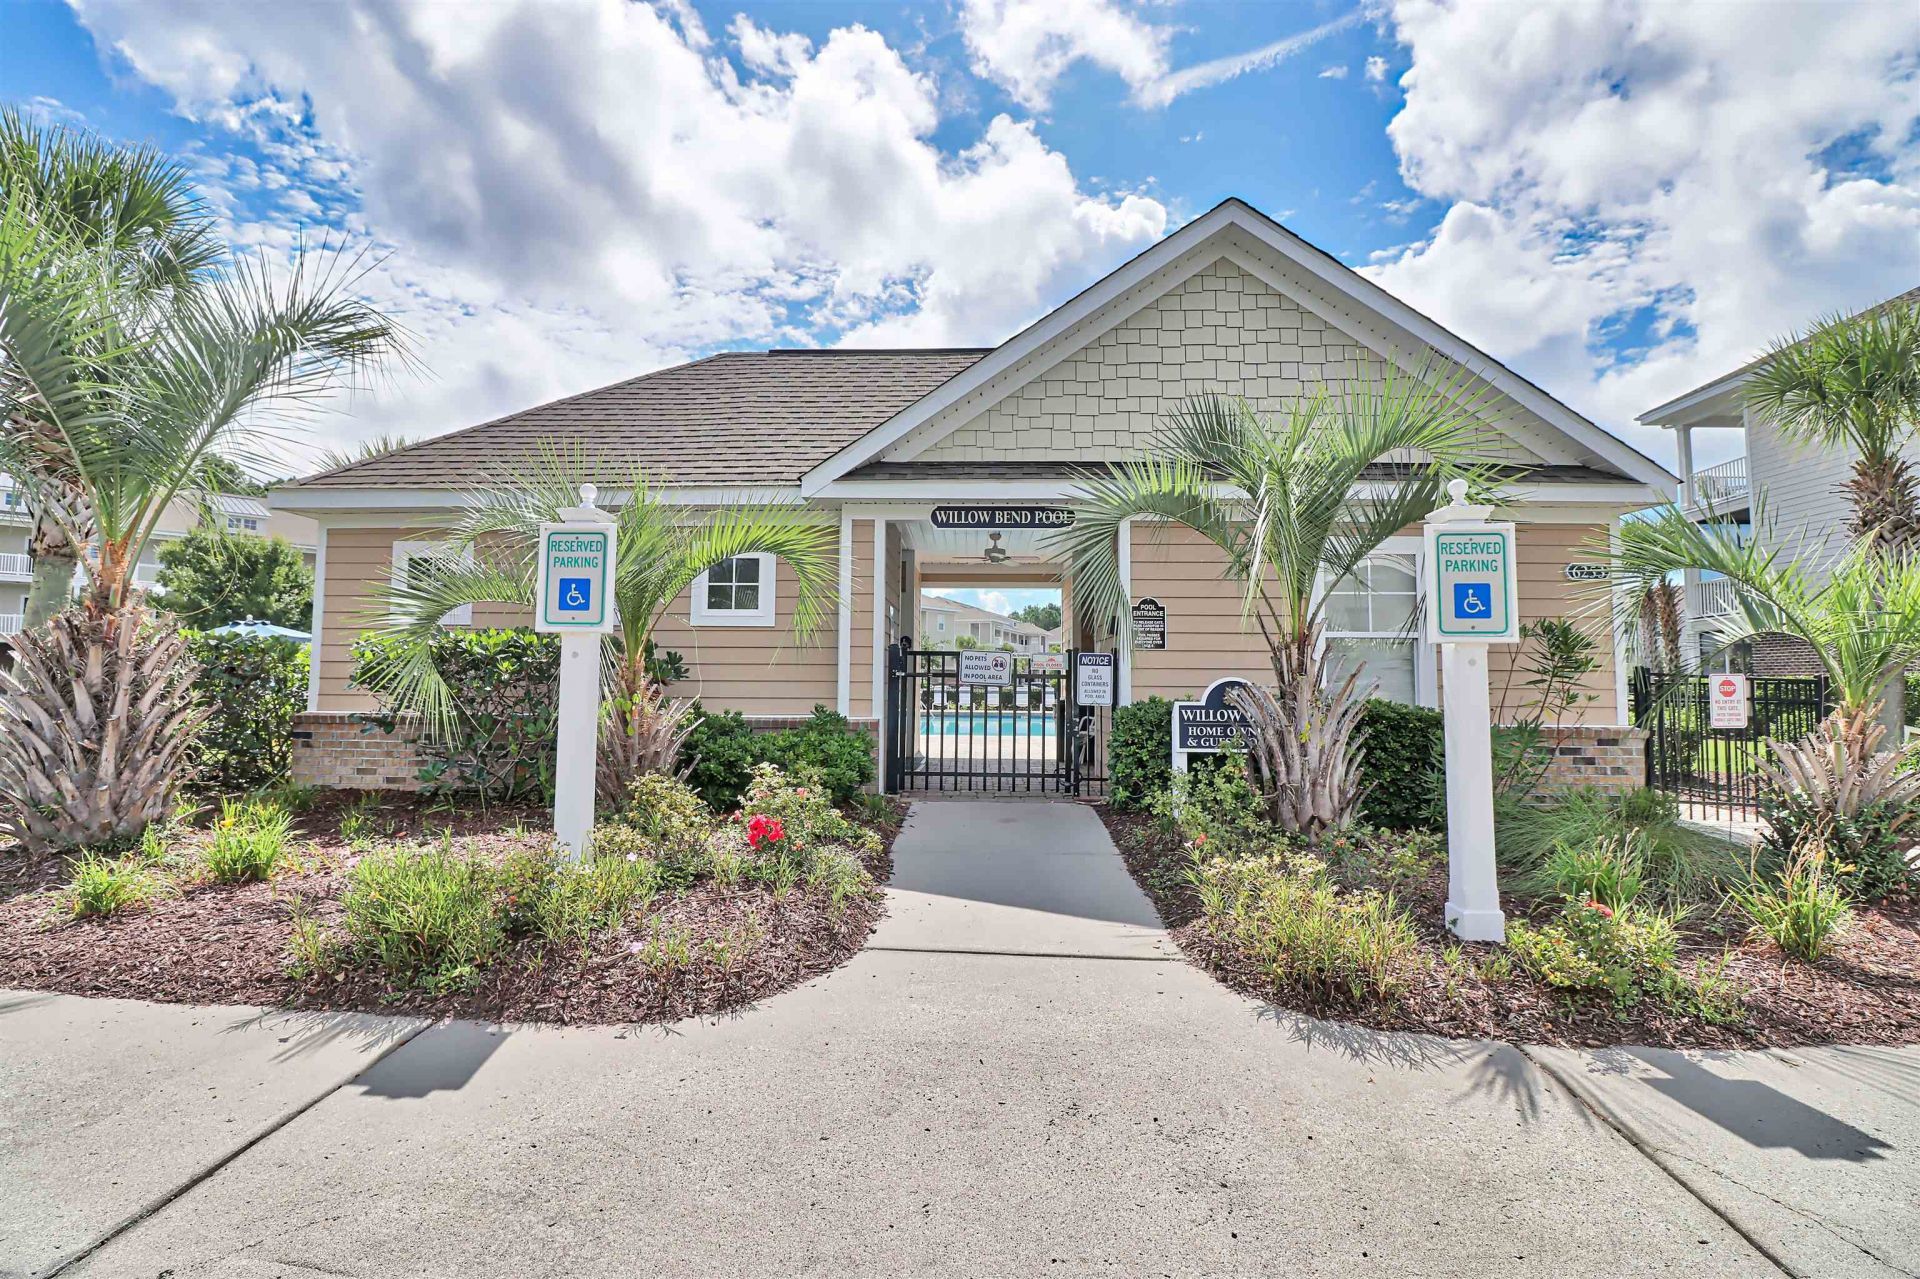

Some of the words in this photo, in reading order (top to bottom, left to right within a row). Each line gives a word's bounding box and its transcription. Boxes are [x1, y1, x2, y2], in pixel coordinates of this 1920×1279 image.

[935, 510, 991, 524] WILLOW
[995, 510, 1031, 524] BEND
[1035, 510, 1072, 524] POOL
[550, 540, 603, 552] RESERVED
[1440, 542, 1501, 555] RESERVED
[553, 556, 599, 568] PARKING
[1445, 559, 1498, 572] PARKING
[1081, 656, 1110, 665] NOTICE
[1181, 709, 1242, 722] WILLOW
[1188, 726, 1224, 736] HOME
[1187, 736, 1198, 747] &
